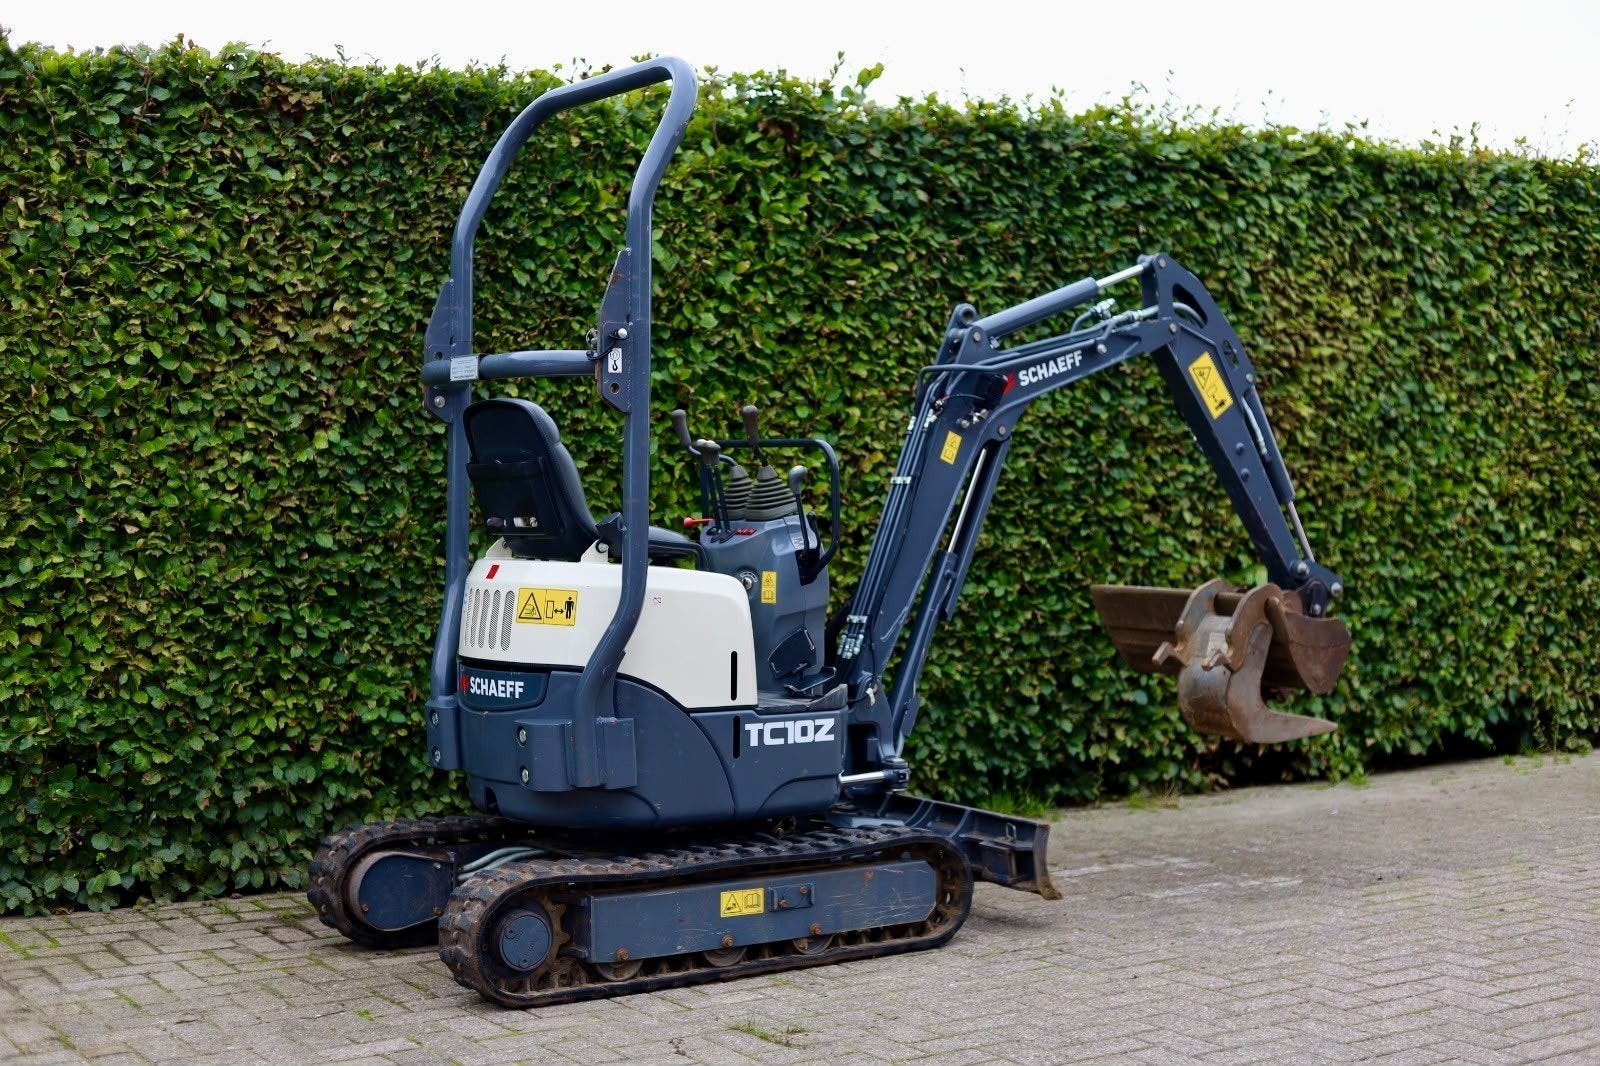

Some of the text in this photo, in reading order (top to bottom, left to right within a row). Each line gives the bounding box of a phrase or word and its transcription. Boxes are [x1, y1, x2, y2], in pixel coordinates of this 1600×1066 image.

[1018, 350, 1082, 386] SCHAEFF
[470, 676, 524, 698] SCHAEFF
[745, 718, 835, 746] TC10Z
